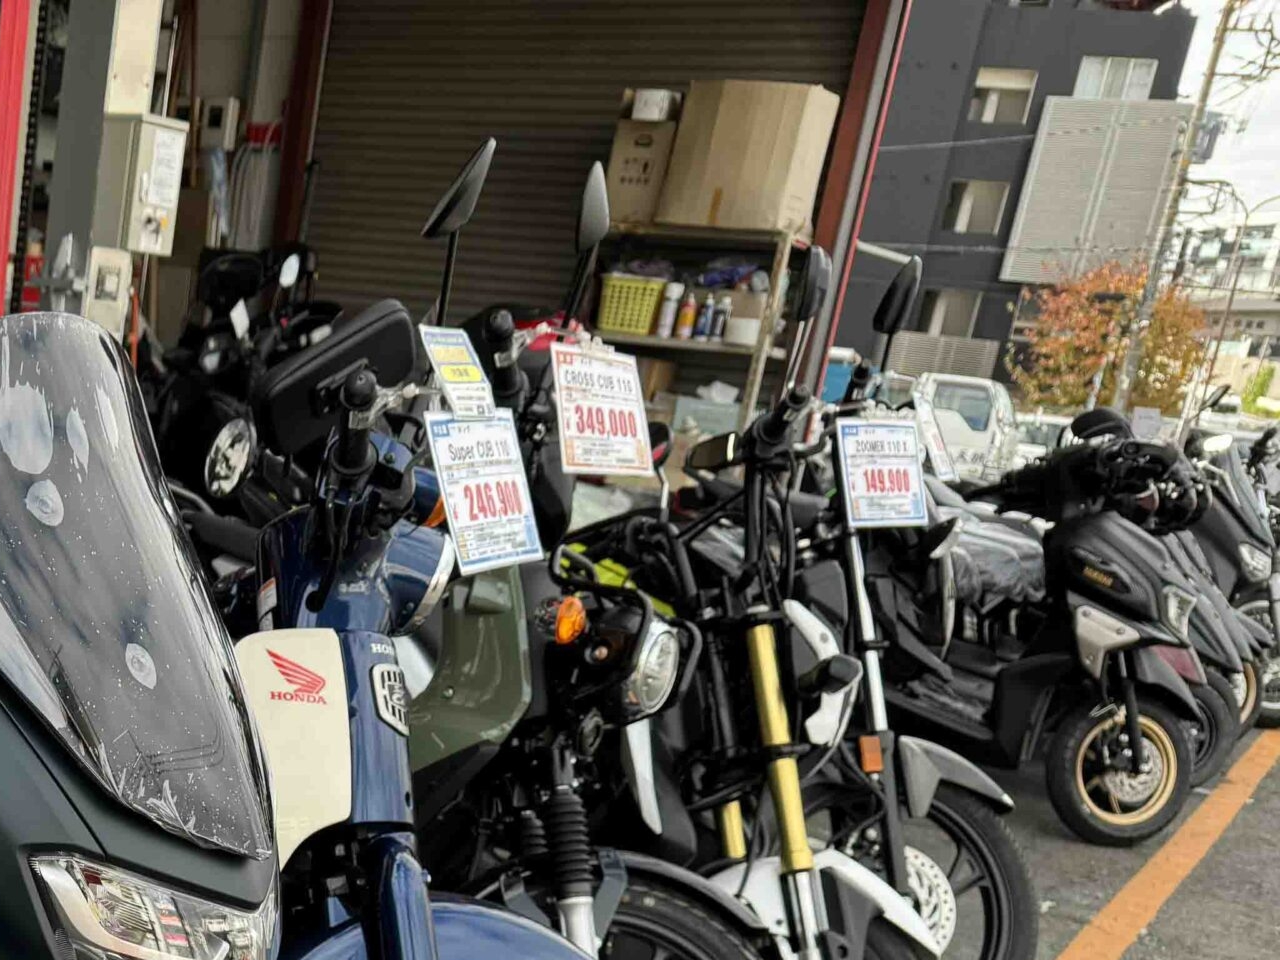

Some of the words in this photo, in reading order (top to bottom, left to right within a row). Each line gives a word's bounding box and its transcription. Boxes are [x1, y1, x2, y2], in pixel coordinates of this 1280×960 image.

[564, 369, 595, 388] CROSS
[597, 374, 616, 390] CUB
[574, 404, 638, 438] 349,000
[448, 443, 475, 462] Super
[476, 440, 495, 458] CUB
[862, 468, 911, 493] 149,900
[463, 479, 524, 521] 246,900
[370, 642, 395, 654] HON
[269, 690, 328, 705] HONDA
